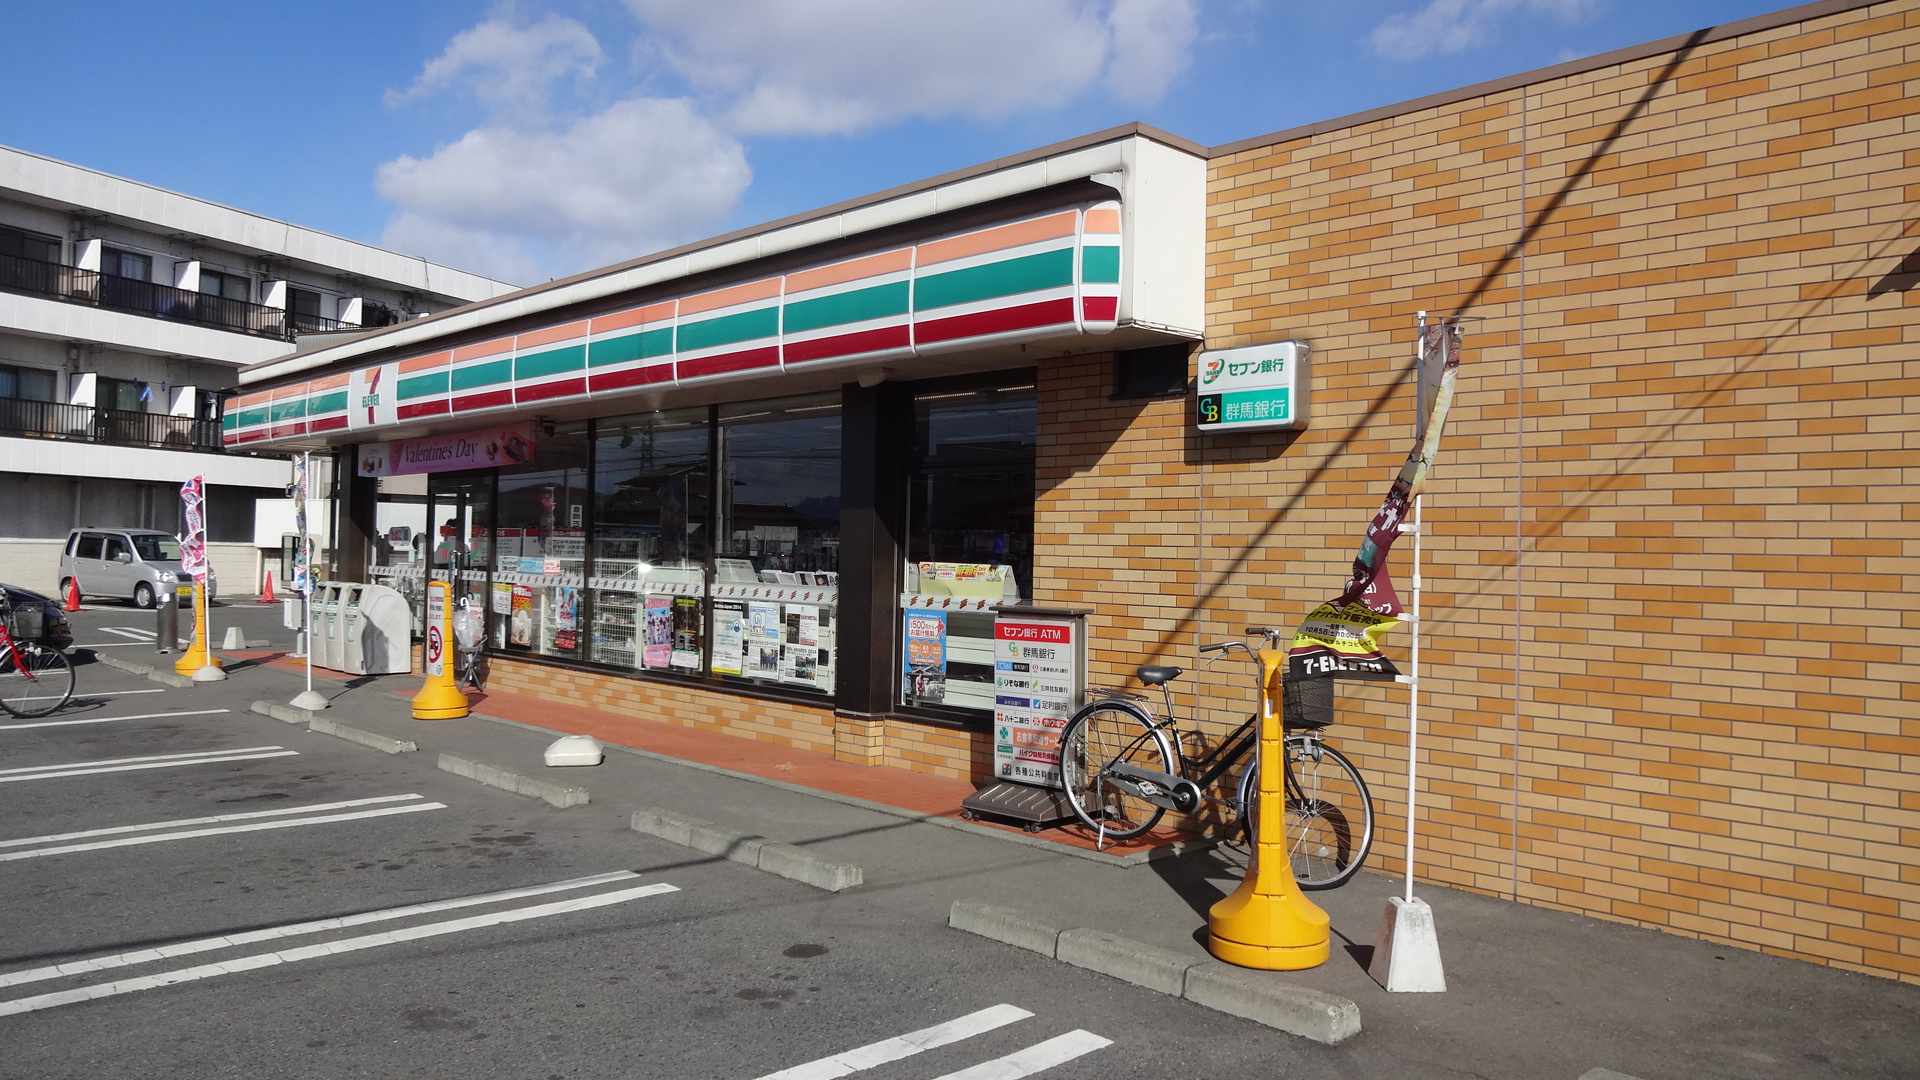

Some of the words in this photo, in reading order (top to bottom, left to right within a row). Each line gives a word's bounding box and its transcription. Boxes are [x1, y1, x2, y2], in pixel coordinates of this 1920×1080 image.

[1228, 358, 1284, 376] セブン銀行
[1225, 400, 1285, 420] 群馬銀行
[405, 441, 453, 463] Valentine's
[455, 439, 478, 463] Day
[1003, 626, 1037, 638] セブン銀行
[1040, 628, 1061, 640] ATM
[1022, 647, 1056, 660] 群馬銀行
[1004, 680, 1029, 689] りそな銀行
[1040, 685, 1069, 694] 三井住友銀行
[1041, 701, 1068, 712] 足利銀行
[1004, 714, 1029, 724] 八十二銀行
